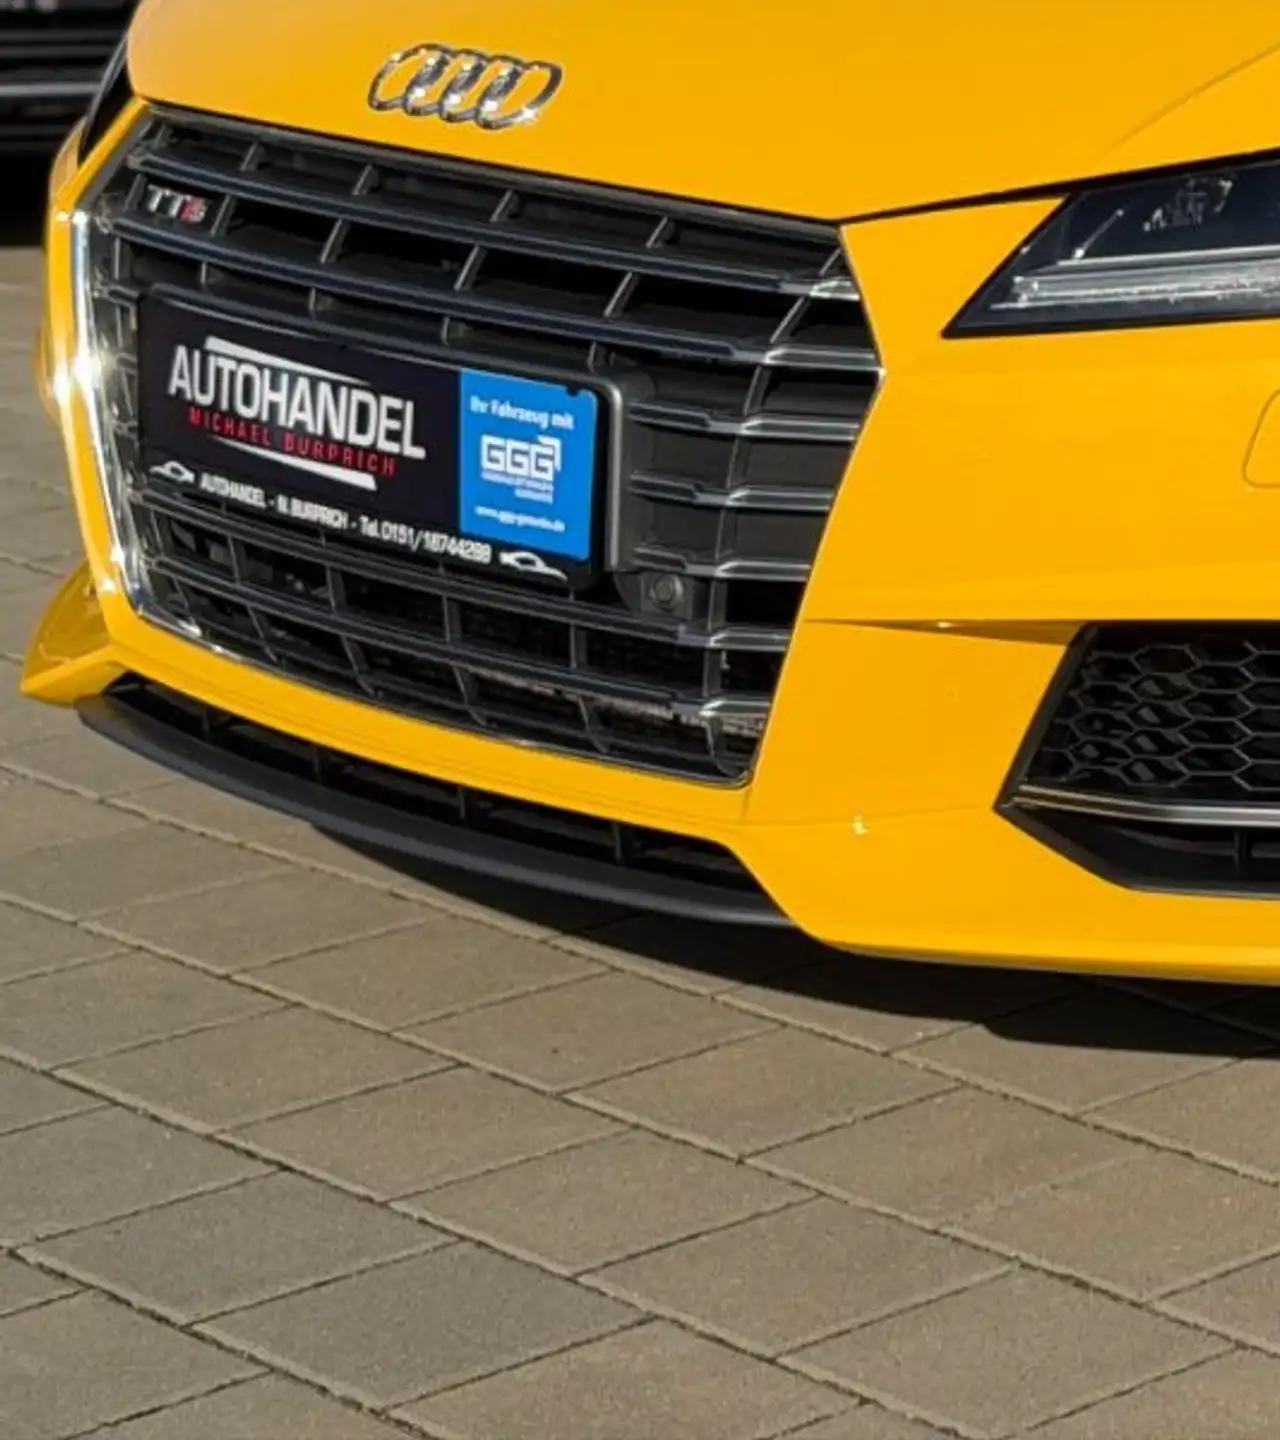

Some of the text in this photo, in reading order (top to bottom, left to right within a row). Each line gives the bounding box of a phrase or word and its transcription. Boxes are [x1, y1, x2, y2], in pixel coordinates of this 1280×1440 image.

[168, 344, 426, 460] AUTOHANDEL
[470, 395, 574, 431] Ihr Fahrzeug mit
[188, 406, 397, 478] MICHAEL BURPRICH
[481, 434, 556, 482] GGG
[200, 472, 267, 509] AUTOHANDEL
